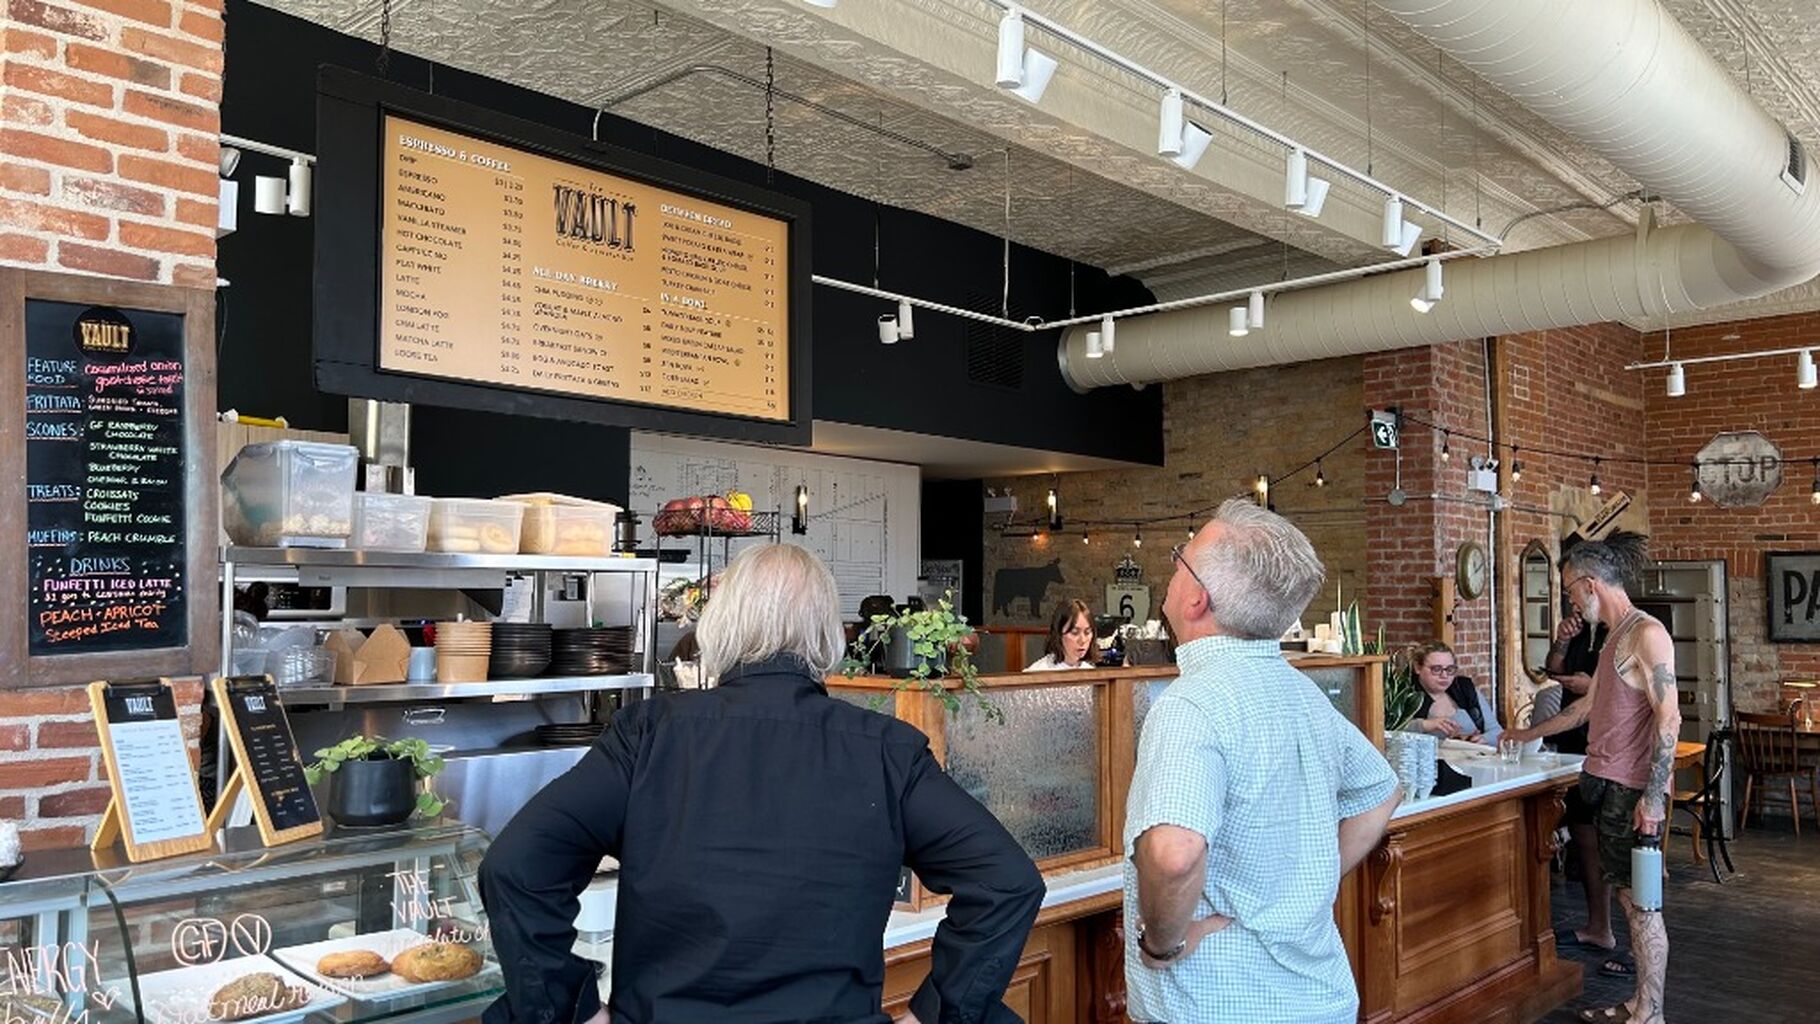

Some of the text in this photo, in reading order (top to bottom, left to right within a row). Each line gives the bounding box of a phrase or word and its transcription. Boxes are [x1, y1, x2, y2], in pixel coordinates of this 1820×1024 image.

[399, 135, 456, 158] ESPRESSO
[471, 153, 511, 172] COFFEE
[80, 322, 131, 349] VAULT
[28, 357, 77, 373] FEATURE
[28, 375, 65, 384] FOOD
[1700, 455, 1778, 484] STOP
[84, 501, 131, 511] COOKIES
[84, 513, 172, 524] FUNFETTI COOKIE
[88, 529, 121, 543] PEACH
[125, 534, 176, 544] CRUMBLE
[70, 557, 131, 572] DRINKS
[44, 579, 172, 592] FUNFETTI ICED LATTE
[40, 608, 94, 626] PEACH
[105, 604, 166, 621] APRICOT
[1119, 594, 1135, 621] 6
[100, 620, 131, 634] Iced
[134, 618, 159, 630] Tea
[125, 697, 154, 713] VAULT
[385, 857, 435, 896] THE
[390, 895, 457, 923] VAULT
